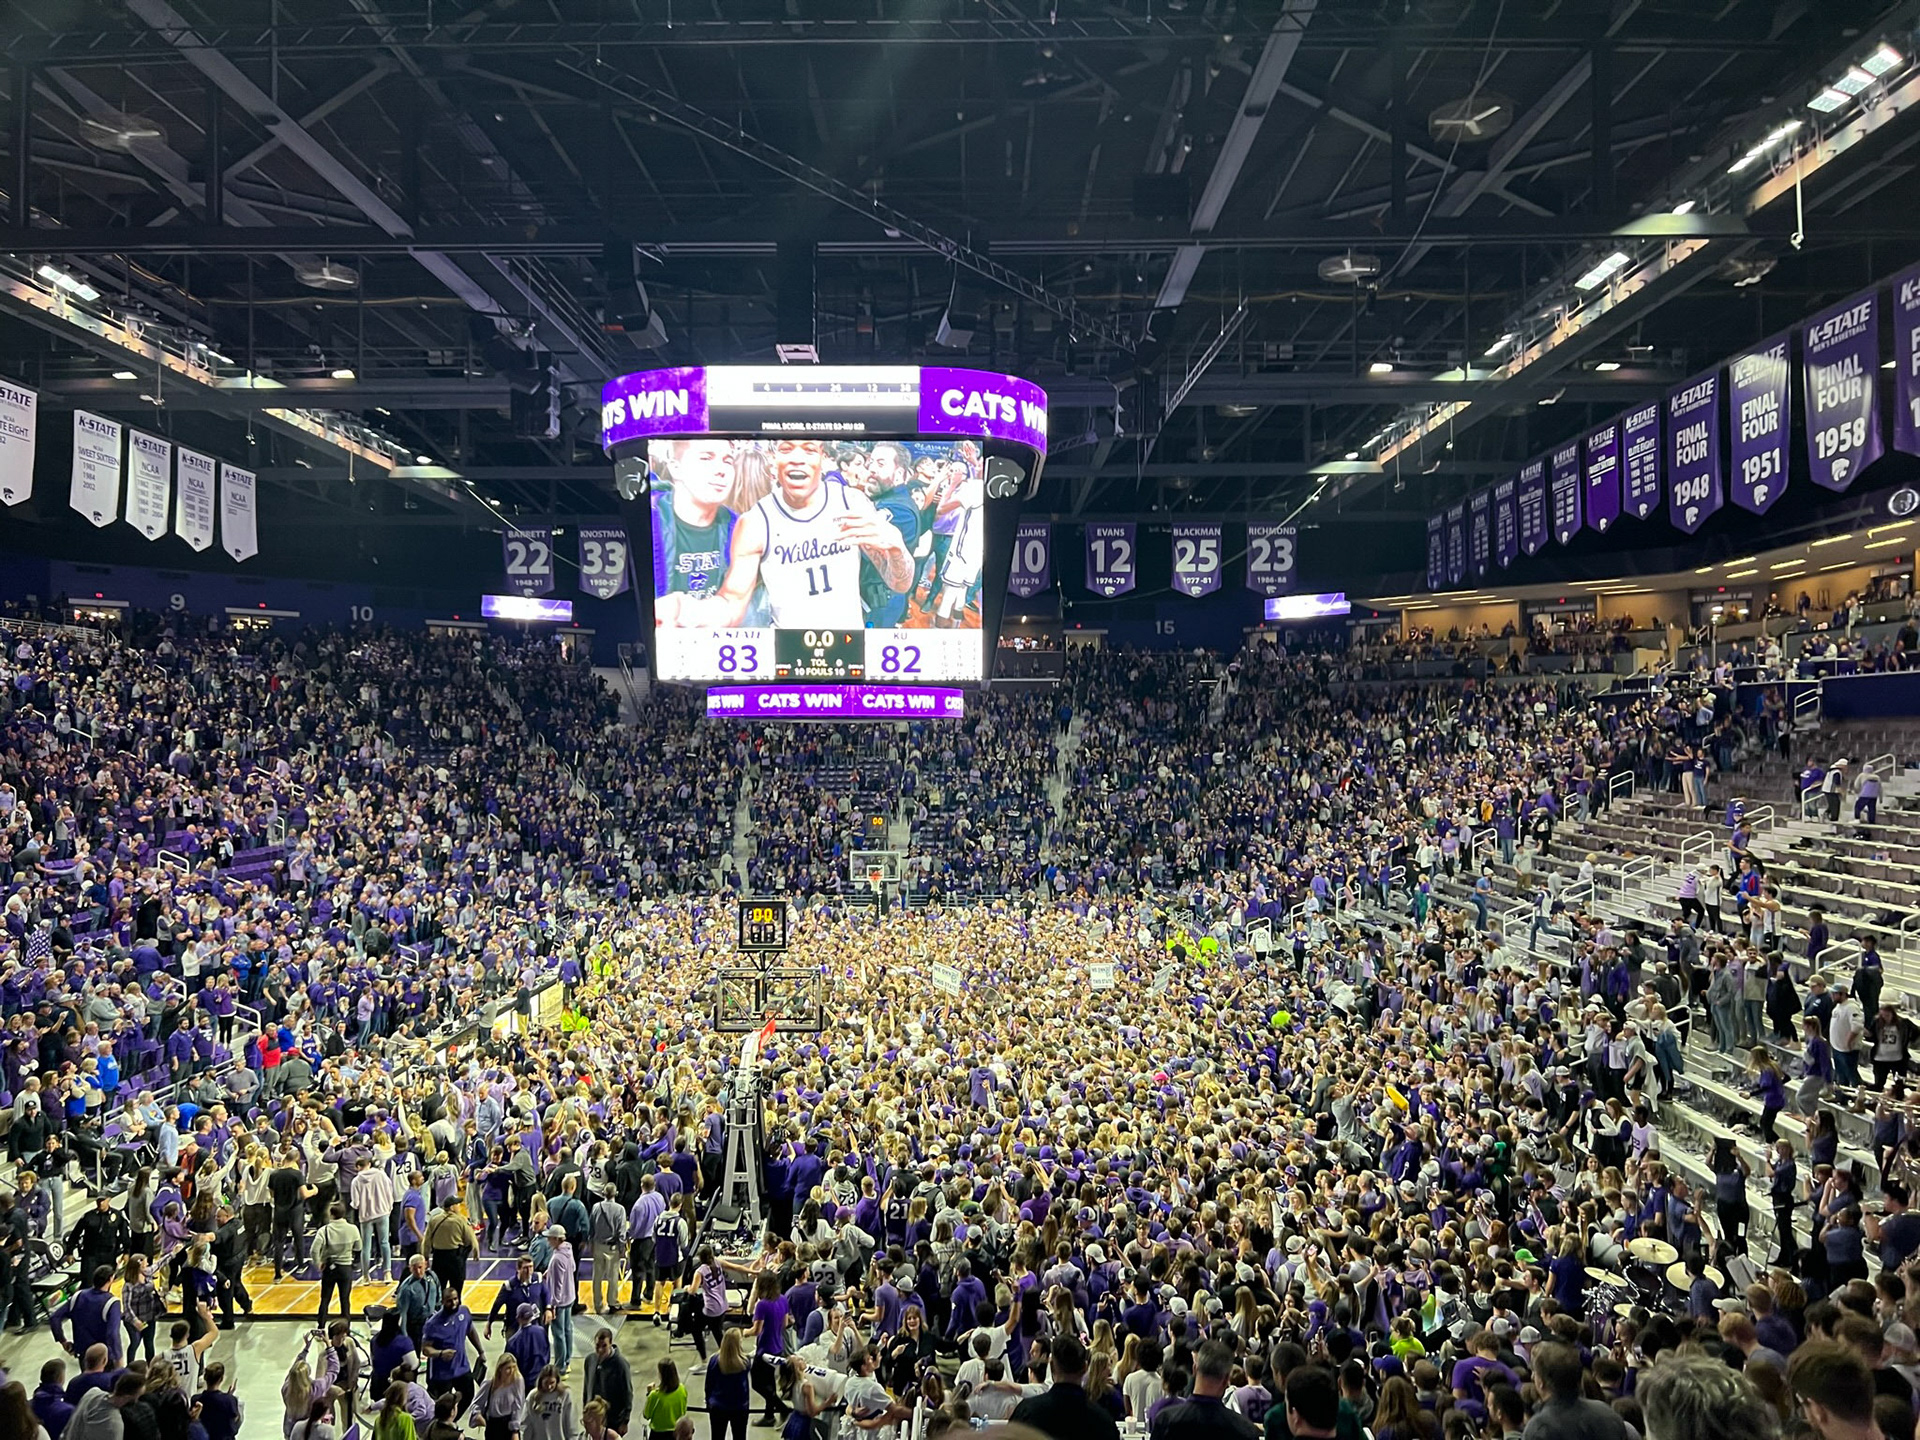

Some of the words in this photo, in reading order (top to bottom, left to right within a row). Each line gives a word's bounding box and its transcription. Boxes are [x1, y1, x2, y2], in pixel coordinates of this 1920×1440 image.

[1808, 300, 1872, 347] K-STATE
[1831, 323, 1867, 347] BASKETBALL
[1818, 353, 1863, 391] FINAL
[0, 387, 32, 407] STATE
[628, 389, 688, 420] WIN
[1671, 378, 1715, 412] K-STATE
[1818, 377, 1862, 413] FOUR
[941, 389, 1017, 423] CATS
[1741, 390, 1779, 422] FINAL
[78, 416, 117, 437] K-STATE
[1626, 405, 1656, 429] K-STATE
[1742, 411, 1778, 443] FOUR
[9, 424, 29, 437] EIGHT
[1589, 426, 1615, 448] K-STATE
[1676, 420, 1708, 449] FINAL
[1815, 417, 1866, 459] 1958
[134, 436, 167, 456] K-STATE
[1676, 440, 1708, 467] FOUR
[141, 462, 159, 474] NCAA
[182, 454, 212, 472] K-STATE
[1742, 448, 1780, 484] 1951
[188, 478, 205, 490] NCAA
[225, 469, 253, 486] K-STATE
[1674, 473, 1709, 506] 1948
[580, 530, 626, 539] KNOSTMAN
[1017, 528, 1047, 537] LIAMS
[1097, 528, 1125, 537] EVANS
[1173, 527, 1221, 537] BLACKMAN
[1248, 526, 1297, 536] RICHMOND
[507, 541, 549, 575] 22
[582, 541, 626, 575] 33
[1011, 540, 1046, 574] 10
[1091, 540, 1131, 573] 12
[1175, 539, 1219, 573] 25
[1251, 538, 1294, 572] 23
[806, 564, 833, 596] 11
[170, 594, 185, 611] 9
[351, 605, 374, 621] 10
[894, 632, 908, 640] KU
[1155, 620, 1175, 635] 15
[804, 630, 835, 647] 0.0
[718, 645, 758, 673] 83
[811, 658, 828, 667] TOL
[881, 645, 922, 673] 82
[795, 668, 805, 676] 10
[806, 668, 834, 677] FOULS
[835, 668, 846, 676] 10
[758, 694, 800, 708] CATS
[803, 693, 843, 708] WIN
[862, 694, 905, 709] CATS
[907, 694, 936, 709] WIN
[1257, 930, 1266, 939] 23
[396, 1161, 412, 1175] 23
[890, 1203, 908, 1219] 21
[657, 1218, 676, 1237] 21
[814, 1271, 836, 1286] 23
